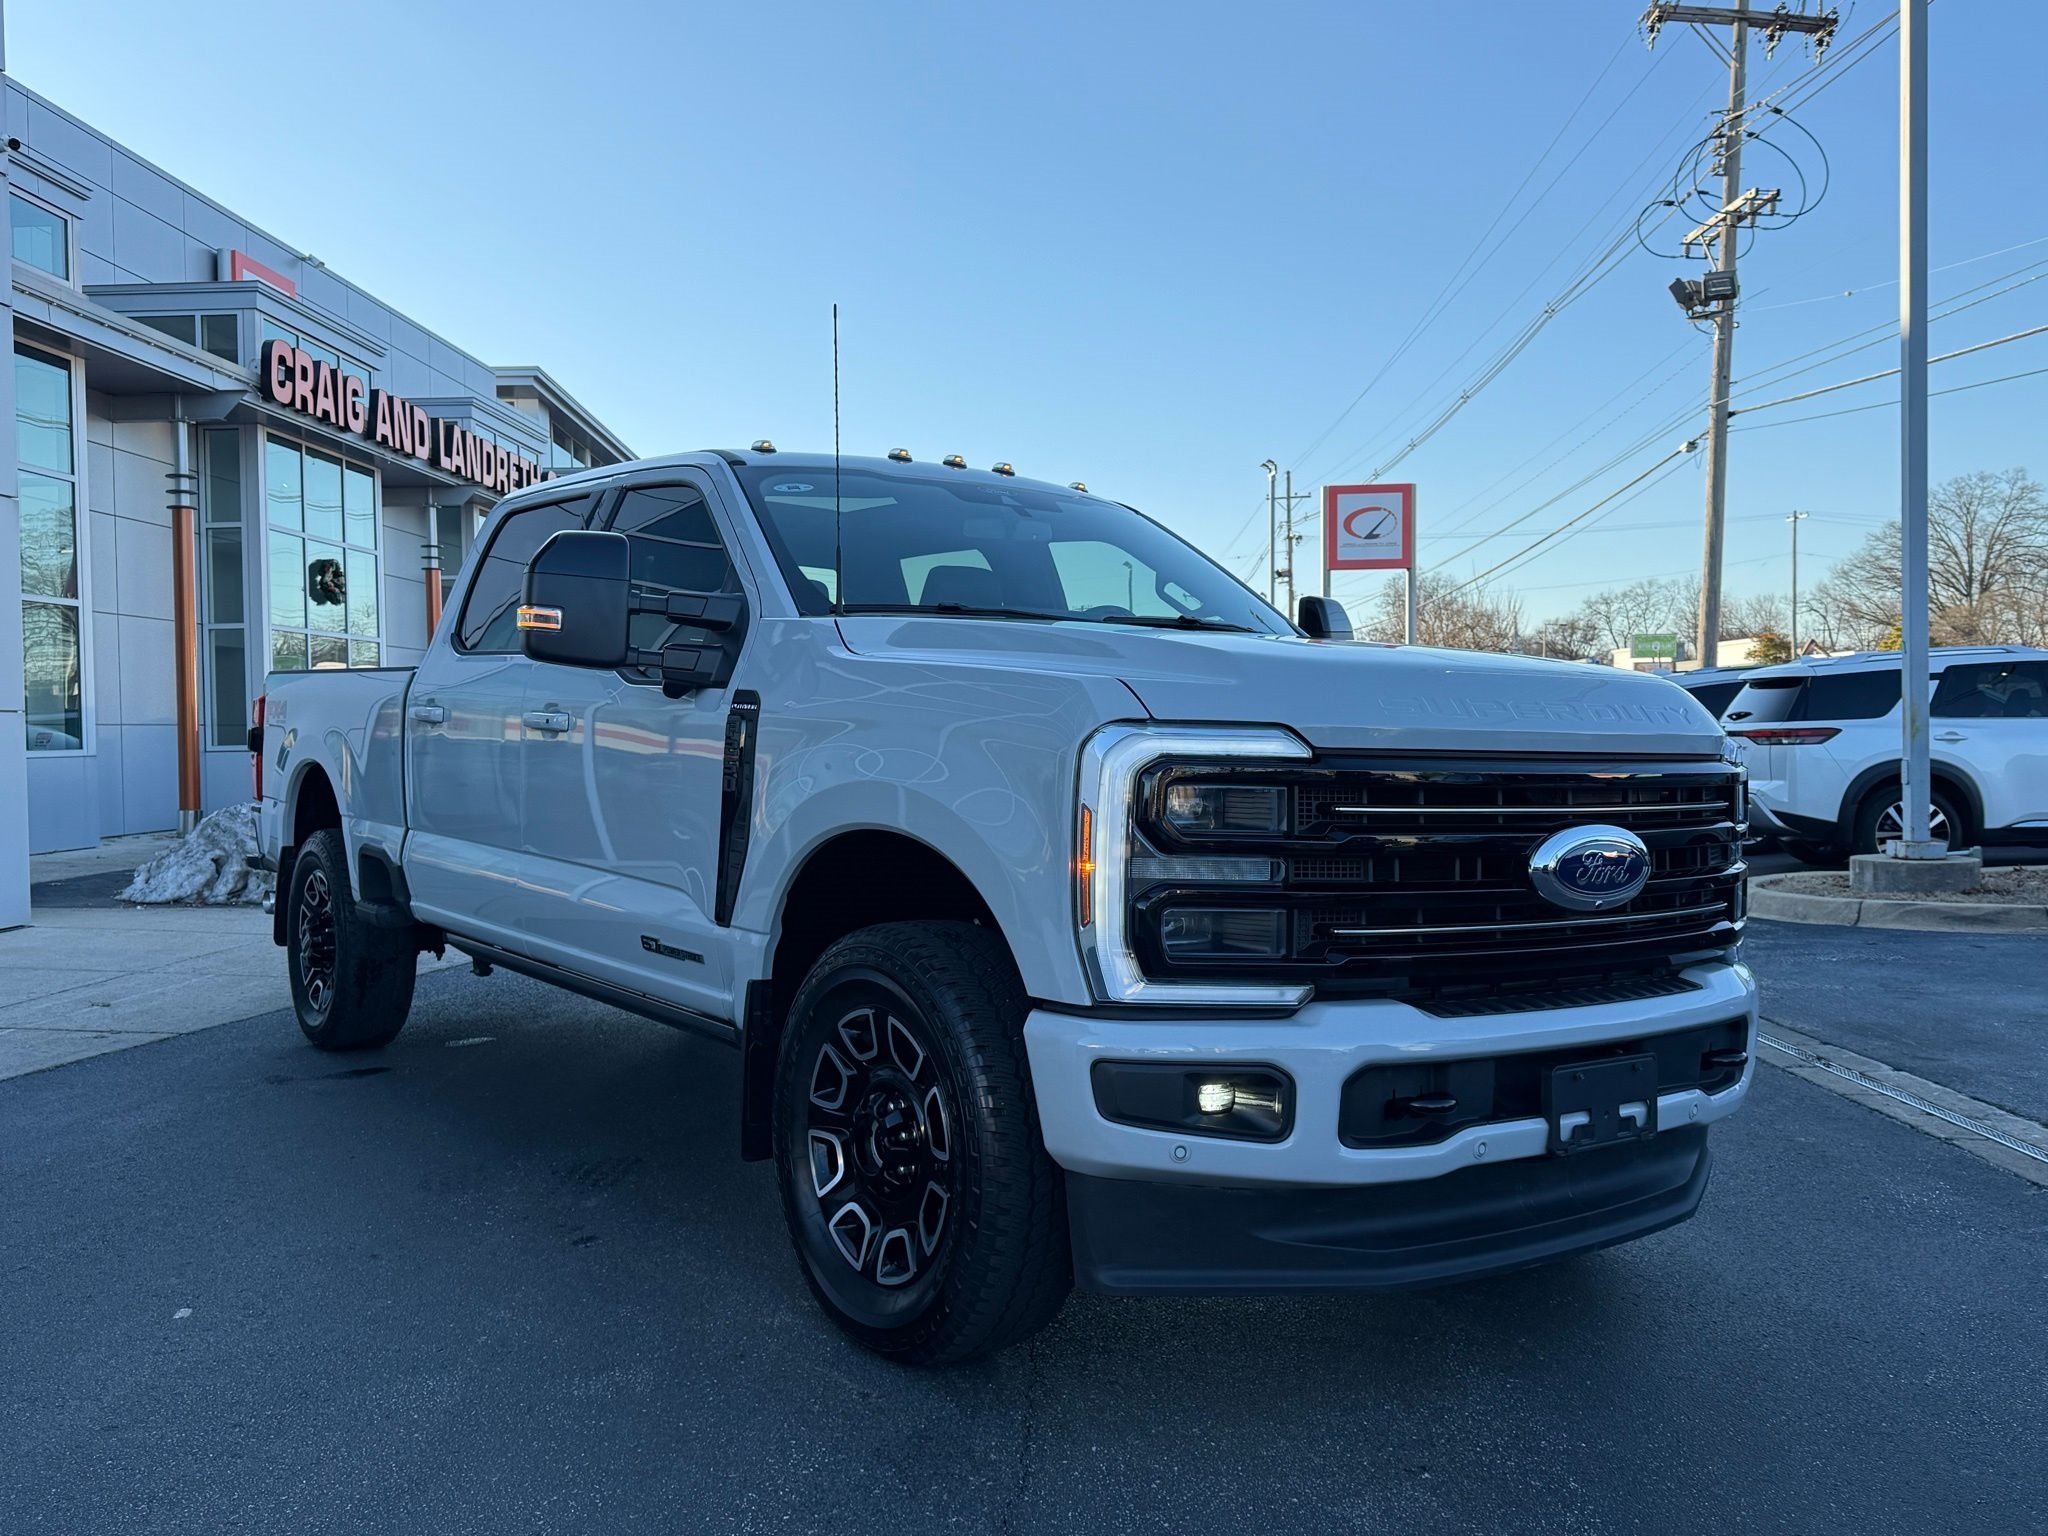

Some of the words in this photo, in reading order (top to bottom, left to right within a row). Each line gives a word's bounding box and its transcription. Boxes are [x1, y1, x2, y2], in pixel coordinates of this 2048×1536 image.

[268, 339, 366, 435] CRAIG
[374, 388, 431, 461] AND
[1376, 695, 1584, 721] SUPER
[1584, 702, 1693, 726] DUTY
[1576, 849, 1637, 886] Ford
